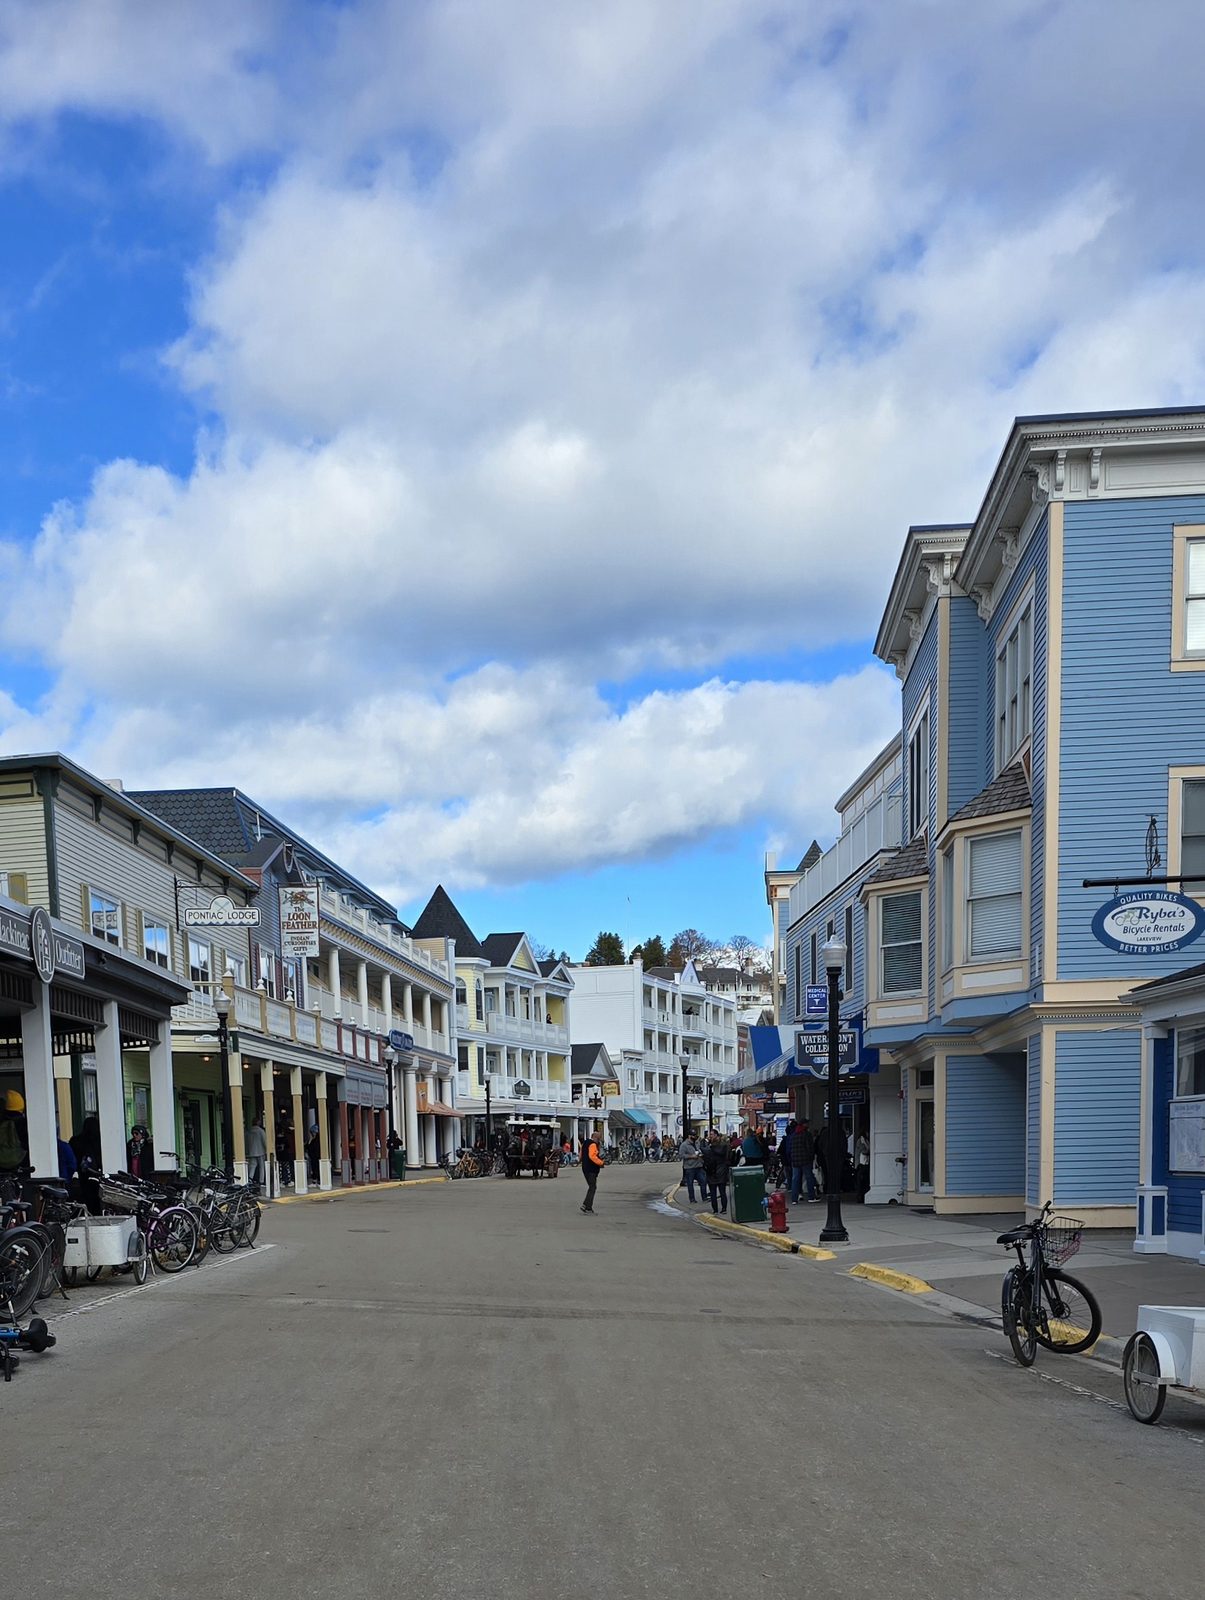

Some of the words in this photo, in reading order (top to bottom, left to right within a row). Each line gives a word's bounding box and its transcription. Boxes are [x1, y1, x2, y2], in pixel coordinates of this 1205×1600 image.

[1120, 892, 1153, 904] QUALITY
[1155, 893, 1178, 902] BIKES
[188, 911, 224, 920] PONTIAC
[227, 911, 257, 920] LODGE
[287, 912, 311, 921] LOON
[1137, 906, 1186, 924] Ryba's
[281, 920, 318, 930] FEATHER
[1122, 924, 1152, 936] Bicycle
[1153, 922, 1186, 933] Rentals
[0, 916, 30, 951] ackinac
[1119, 943, 1148, 953] BETTER
[1150, 941, 1179, 953] PRICES
[55, 940, 82, 970] Outfitter
[800, 1033, 854, 1045] WATERONT
[804, 1043, 849, 1054] COLLEON
